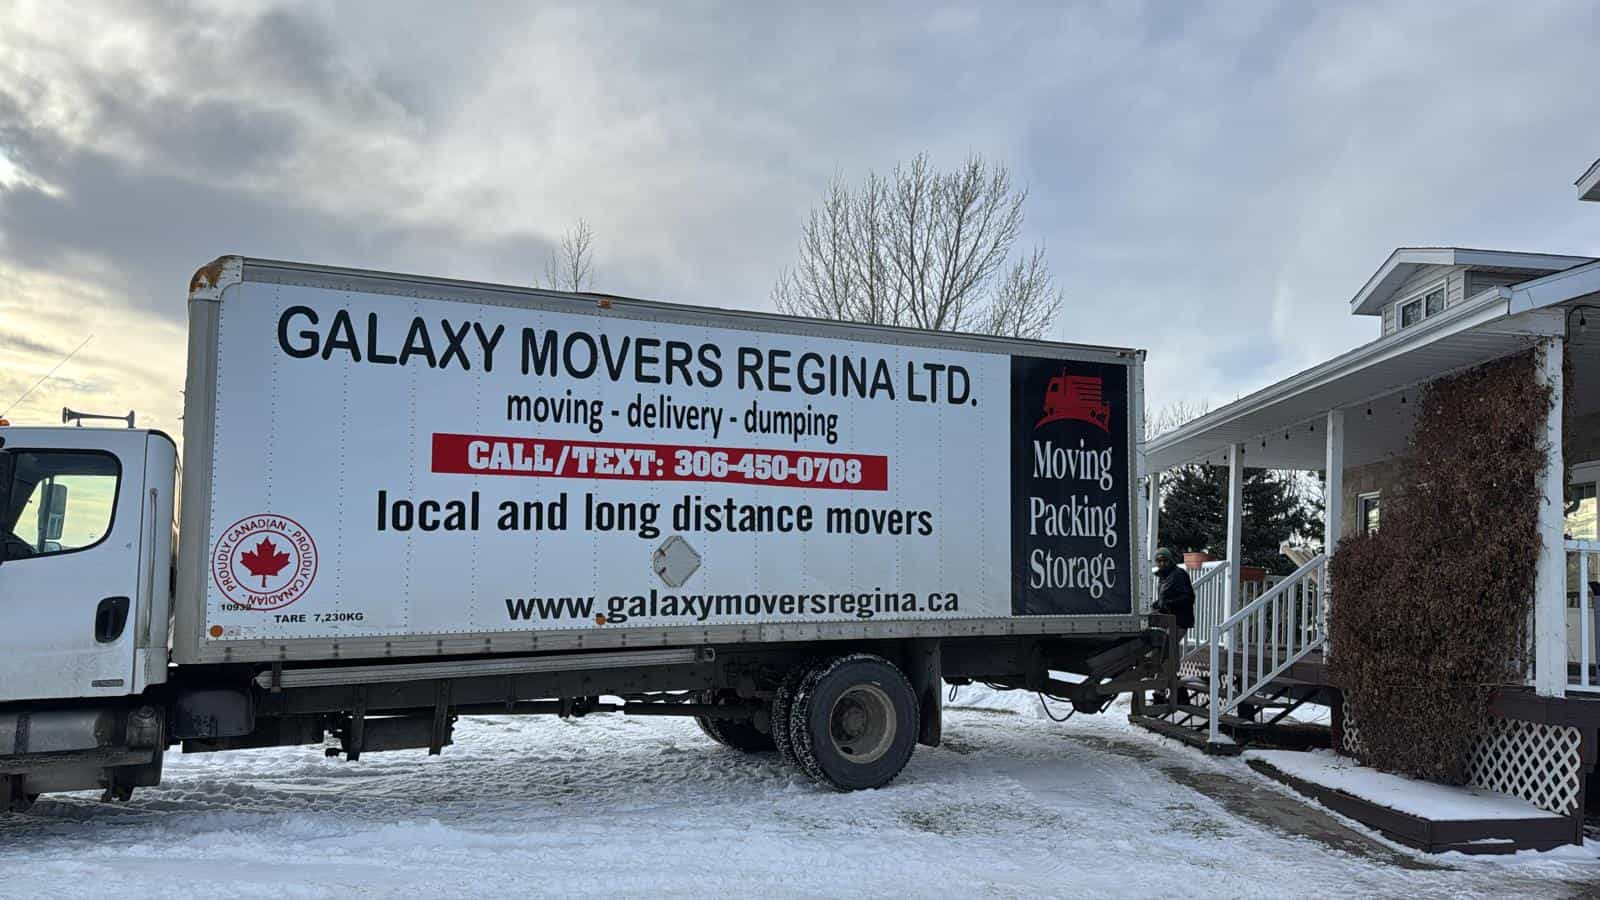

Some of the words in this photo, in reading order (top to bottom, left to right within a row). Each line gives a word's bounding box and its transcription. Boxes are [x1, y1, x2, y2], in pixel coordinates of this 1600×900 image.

[278, 305, 505, 372] GALAXY
[521, 327, 723, 388] MOVERS
[738, 346, 896, 400] REGINA
[908, 360, 978, 407] LTD.
[507, 389, 604, 433] moving
[627, 393, 723, 439] delivery
[744, 400, 839, 444] dumping
[467, 440, 664, 477] CALL/TEXT:
[674, 449, 862, 484] 306-450-0708
[1033, 438, 1112, 491] Moving
[228, 519, 286, 543] CANADIAN
[377, 490, 480, 531] local
[497, 493, 568, 531] and
[585, 493, 661, 539] long
[673, 495, 813, 533] distance
[826, 505, 933, 536] movers
[1030, 494, 1117, 549] Packing
[217, 542, 236, 593] PROUDLY
[292, 530, 313, 580] PROUDLY
[1030, 549, 1116, 599] Storage
[247, 579, 305, 606] CANADIAN
[273, 613, 307, 623] TARE
[313, 612, 364, 623] 7,230KG
